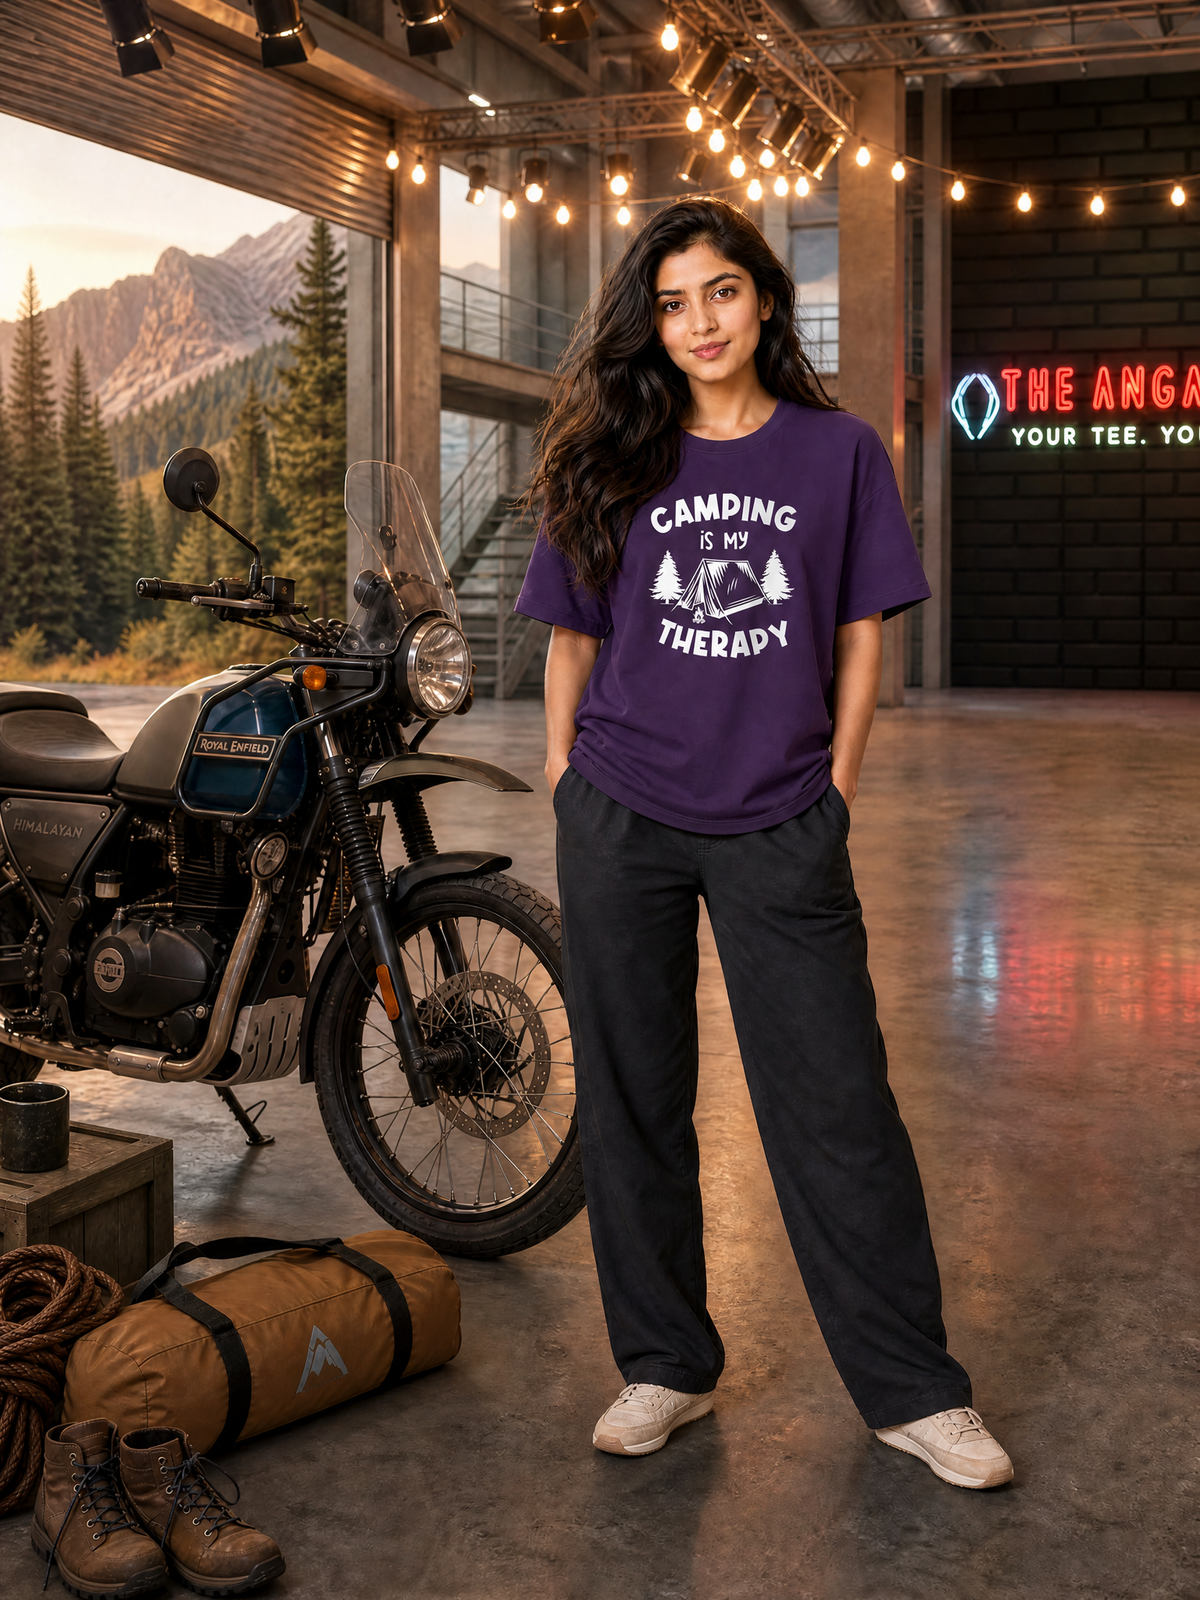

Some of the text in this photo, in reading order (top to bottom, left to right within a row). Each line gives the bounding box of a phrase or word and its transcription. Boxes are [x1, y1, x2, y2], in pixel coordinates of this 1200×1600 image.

[1001, 367, 1074, 412] THE
[1011, 424, 1200, 446] YOUR TEE. YO
[650, 493, 797, 534] CAMPING
[723, 531, 749, 550] MY
[658, 618, 788, 659] THERAPY
[200, 738, 270, 755] ROYAL ENFIELD
[13, 818, 84, 839] HIMALAYAN
